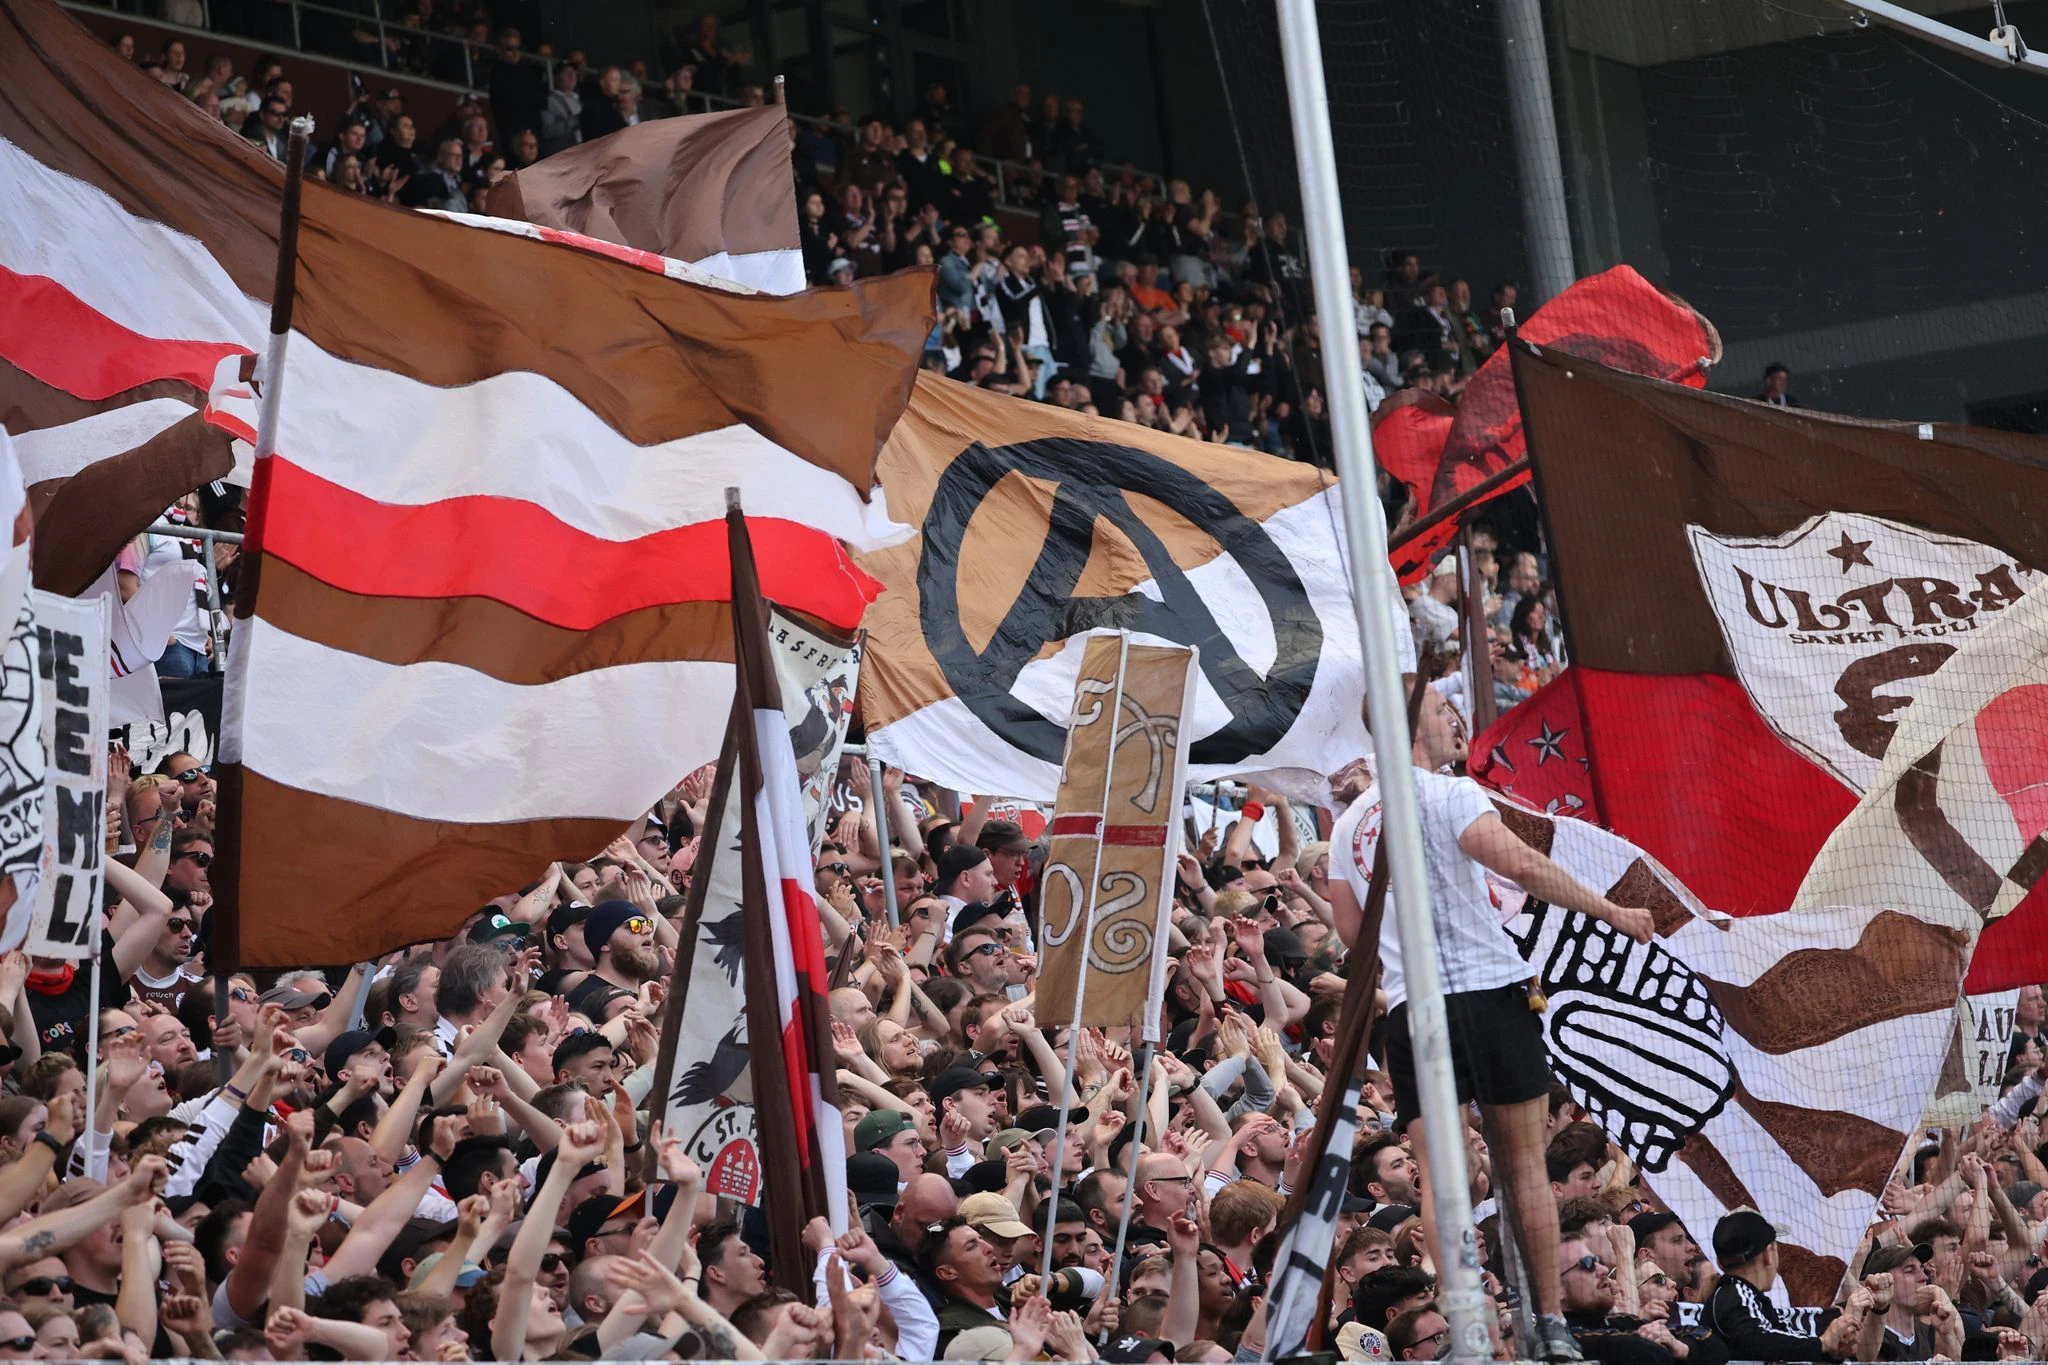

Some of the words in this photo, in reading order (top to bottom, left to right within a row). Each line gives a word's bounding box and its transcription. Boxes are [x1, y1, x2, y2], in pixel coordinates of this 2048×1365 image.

[1789, 631, 1884, 645] SANKT
[146, 991, 174, 999] reusch
[715, 1112, 741, 1145] ST.
